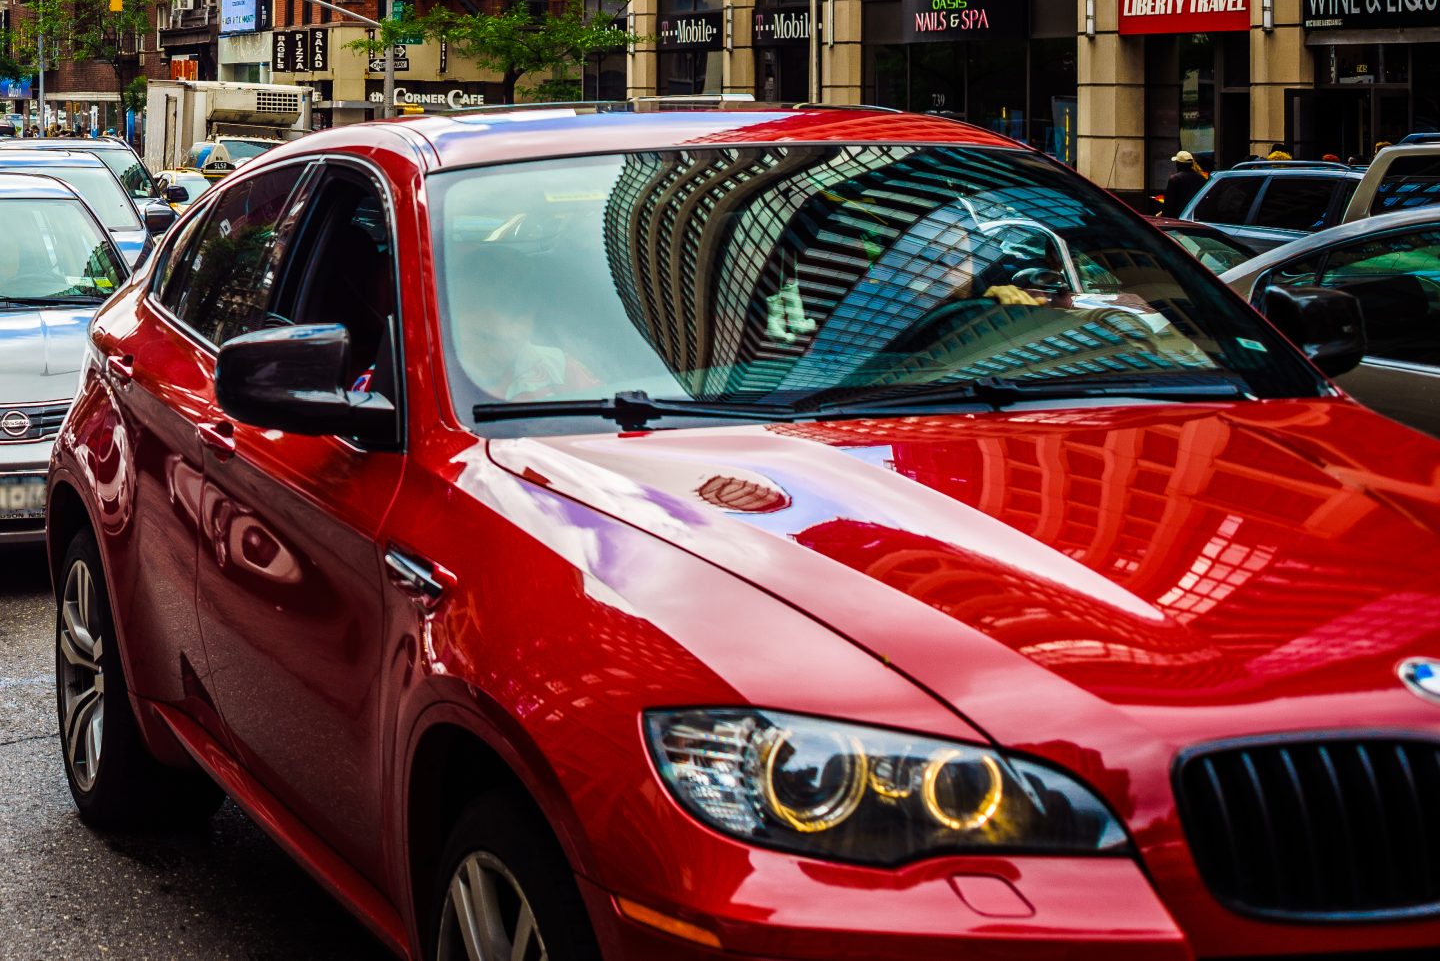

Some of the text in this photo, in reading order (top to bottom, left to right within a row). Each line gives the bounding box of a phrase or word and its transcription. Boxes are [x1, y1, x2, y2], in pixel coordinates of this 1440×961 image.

[915, 9, 989, 31] NAILS & SPA
[277, 35, 285, 69] BAGELS
[296, 33, 304, 70] PIZZA
[315, 31, 323, 68] SALAD
[394, 88, 445, 105] CORNER
[447, 90, 484, 109] CAFE
[932, 94, 945, 107] 739
